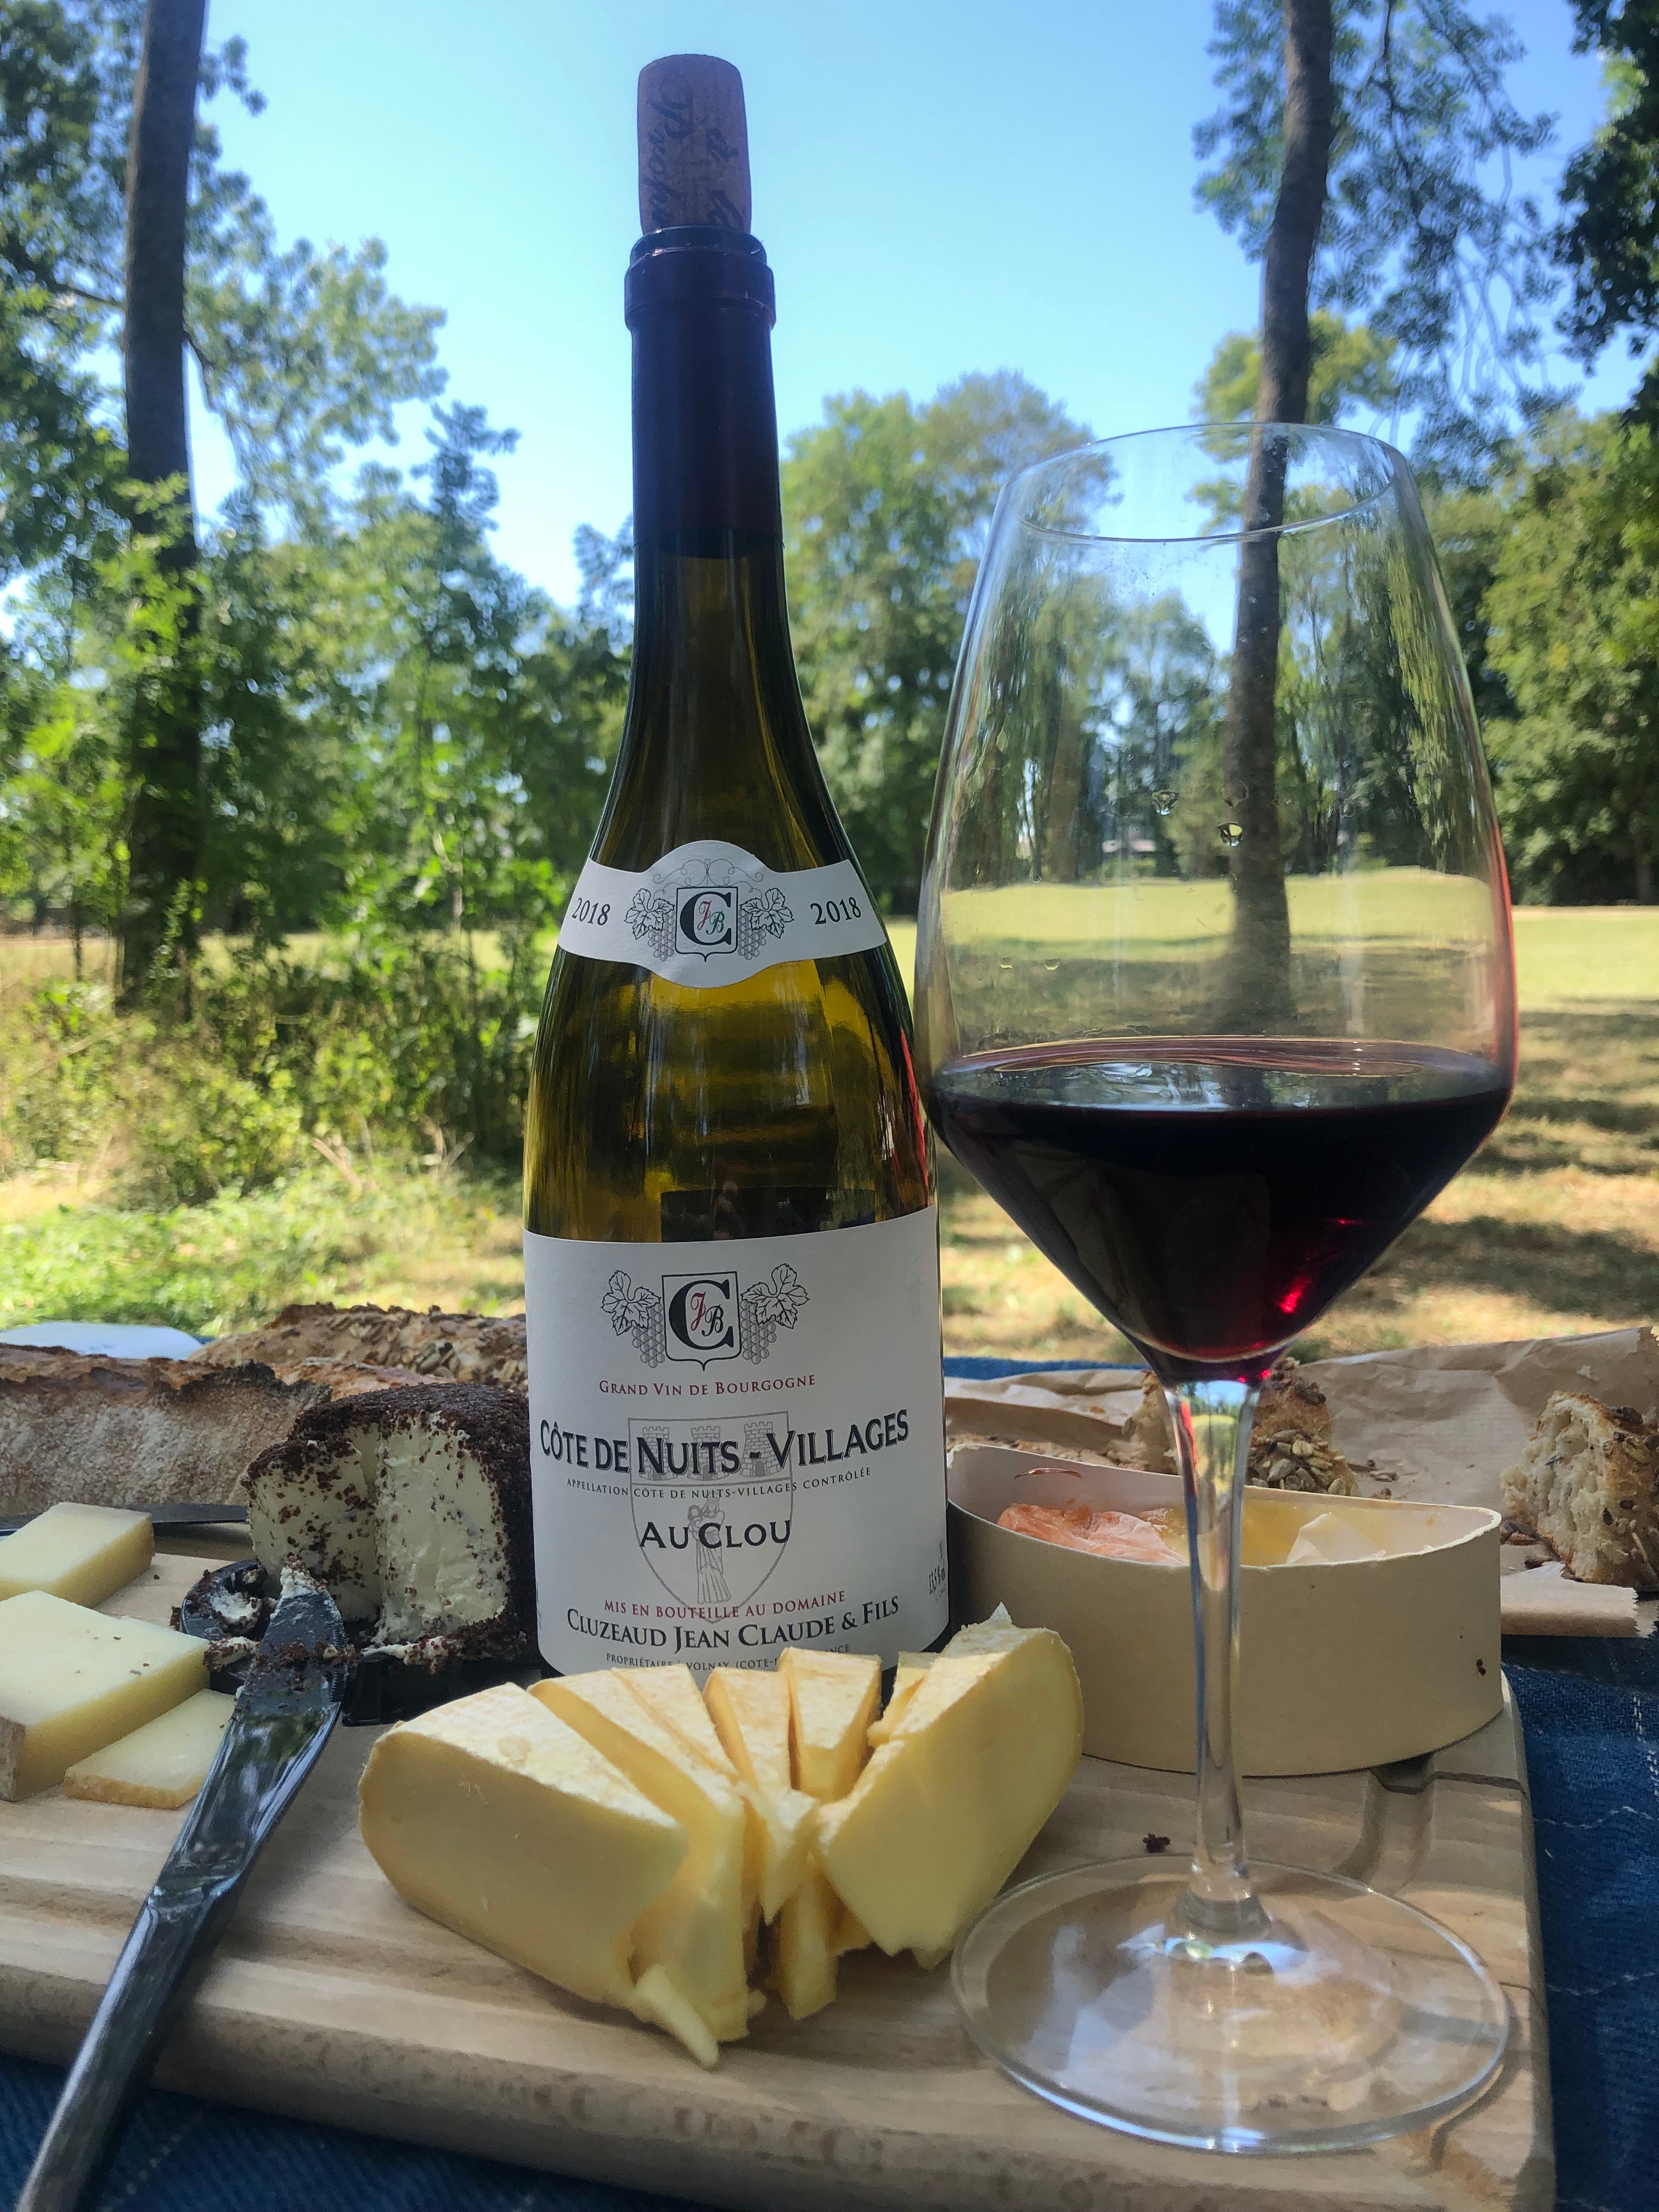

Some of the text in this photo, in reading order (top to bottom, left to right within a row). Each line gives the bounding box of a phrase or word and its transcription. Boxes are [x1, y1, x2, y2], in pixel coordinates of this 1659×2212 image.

[571, 897, 610, 926] 2018
[810, 896, 862, 925] 2018
[599, 1374, 816, 1396] GRAND VIN DE BOURGOGNE
[540, 1419, 589, 1469] CÔTE
[594, 1437, 630, 1474] DE
[765, 1409, 909, 1469] VILLAGES
[567, 1478, 629, 1496] APPELLATION
[634, 1487, 664, 1498] CÔTE
[670, 1489, 686, 1498] DE
[803, 1466, 871, 1489] CONTRÔLÉE
[639, 1520, 792, 1549] AU CLOU
[605, 1590, 845, 1618] MIS EN BOUTEILLE AU DOMAINE
[568, 1595, 899, 1654] CLUZEAUD JEAN CLAUDE & FILS
